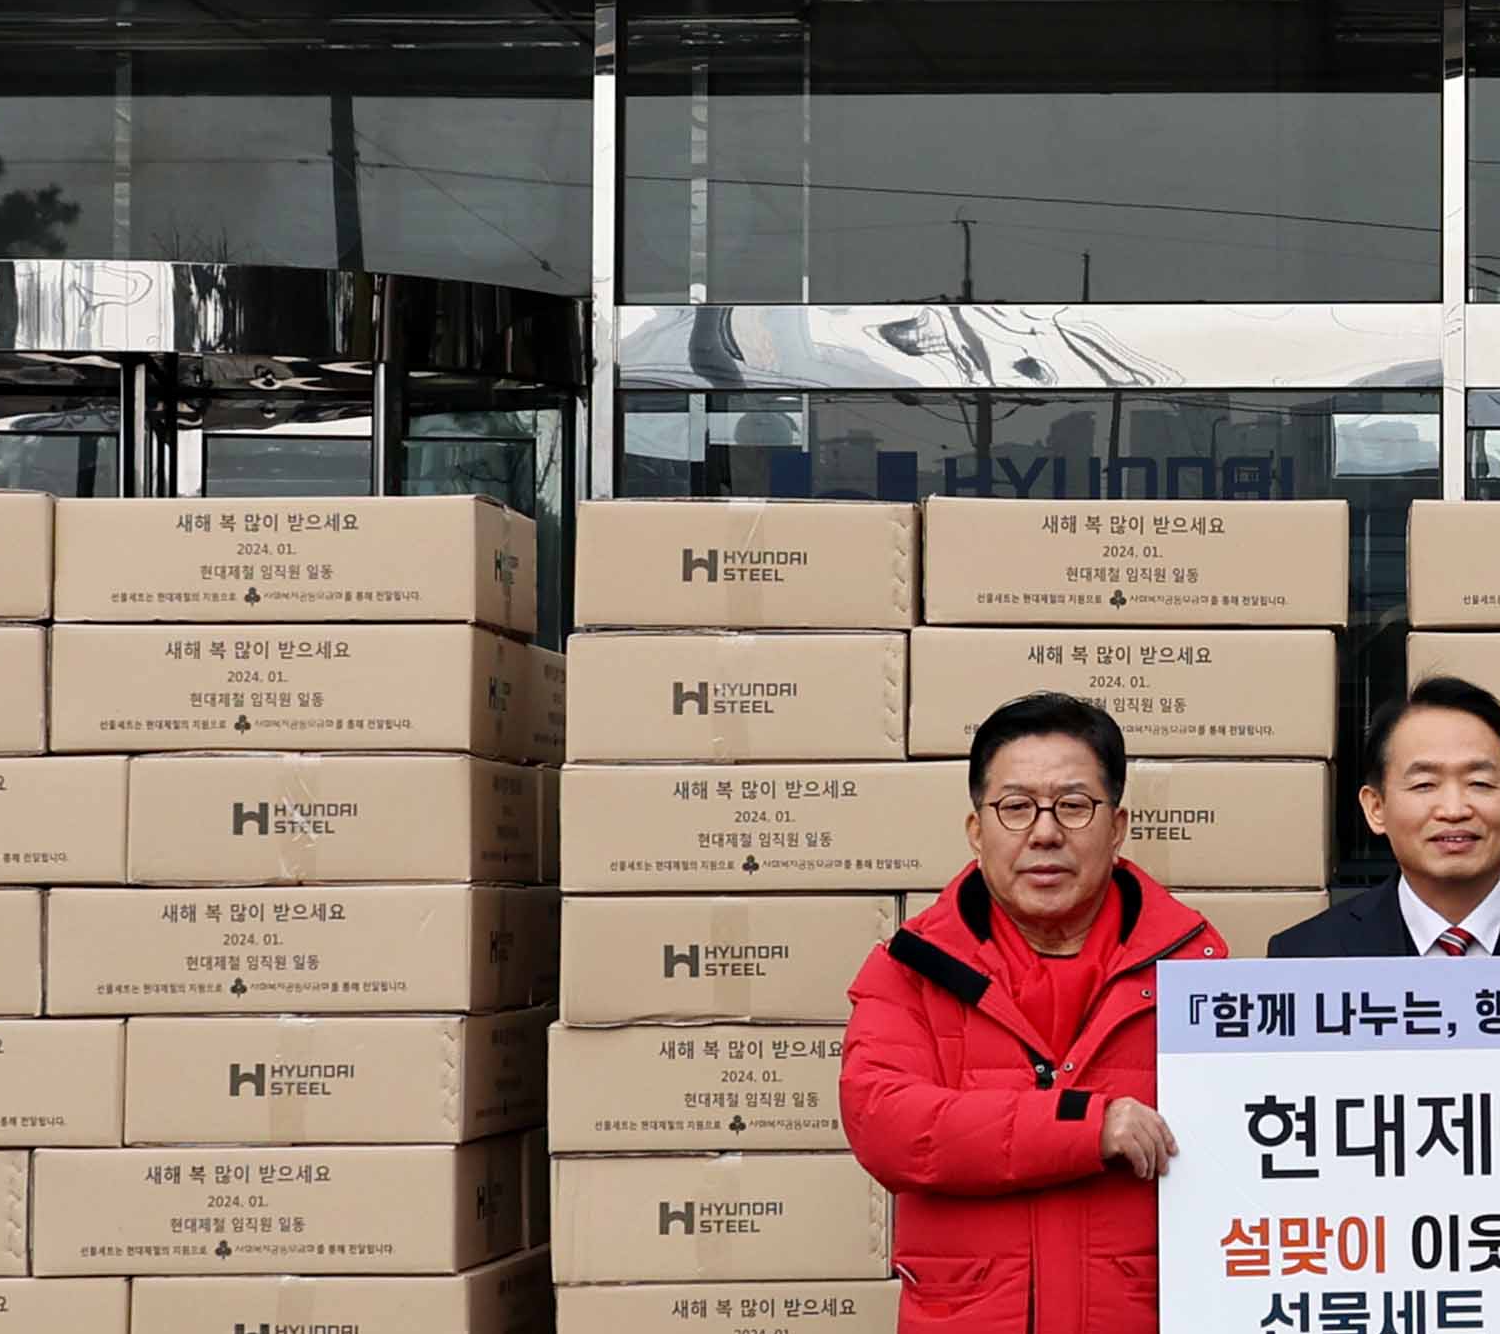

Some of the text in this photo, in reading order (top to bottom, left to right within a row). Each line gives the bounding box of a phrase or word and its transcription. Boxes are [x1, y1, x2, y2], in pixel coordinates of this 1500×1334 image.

[177, 513, 358, 532] 새해 복 많이 받으세요
[1042, 515, 1225, 535] 새해 복 많이 받으세요
[237, 543, 296, 555] 2024. 01.
[1103, 546, 1162, 557] 2024. 01.
[724, 551, 807, 565] HYUNDAI
[201, 565, 333, 579] 현대제철 임직원 일동
[724, 568, 784, 581] STEEL
[1067, 567, 1198, 583] 현대제철 임직원 일동
[1190, 993, 1295, 1037] 『함께
[1316, 992, 1456, 1037] 나누는,
[1222, 1217, 1384, 1276] 설맞이
